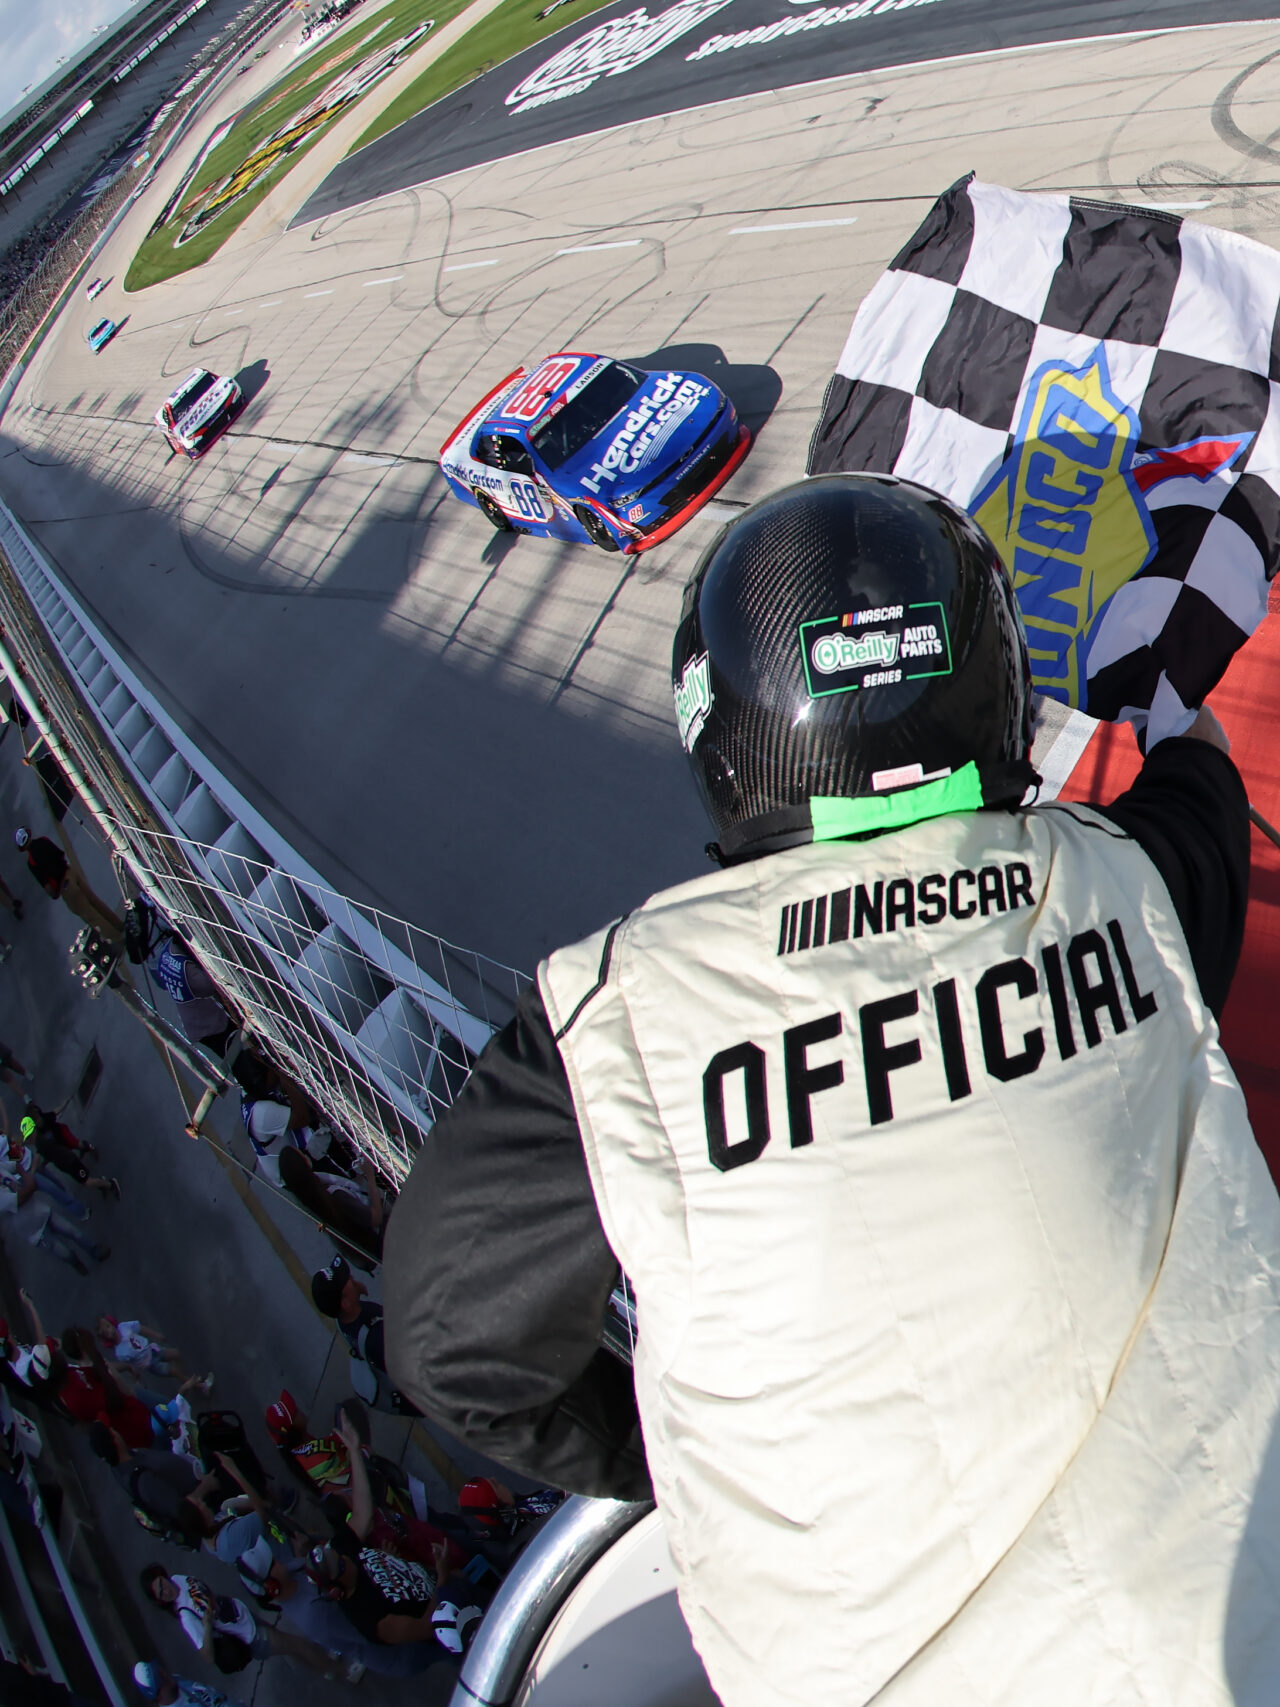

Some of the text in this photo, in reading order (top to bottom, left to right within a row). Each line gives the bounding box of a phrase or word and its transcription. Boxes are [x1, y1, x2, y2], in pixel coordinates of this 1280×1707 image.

[502, 357, 581, 421] 88
[575, 362, 605, 389] LARSON
[579, 371, 684, 494] Hendrick
[618, 379, 702, 474] Cars.com
[510, 480, 548, 521] 88
[630, 505, 643, 521] 88
[1013, 383, 1116, 707] UNOCO
[857, 605, 904, 625] NASCAR
[815, 625, 937, 670] O'Reilly AUTO
[901, 639, 943, 658] PARTS
[863, 669, 902, 688] SERIES
[853, 861, 1037, 938] NASCAR
[702, 918, 1159, 1172] OFFICIAL
